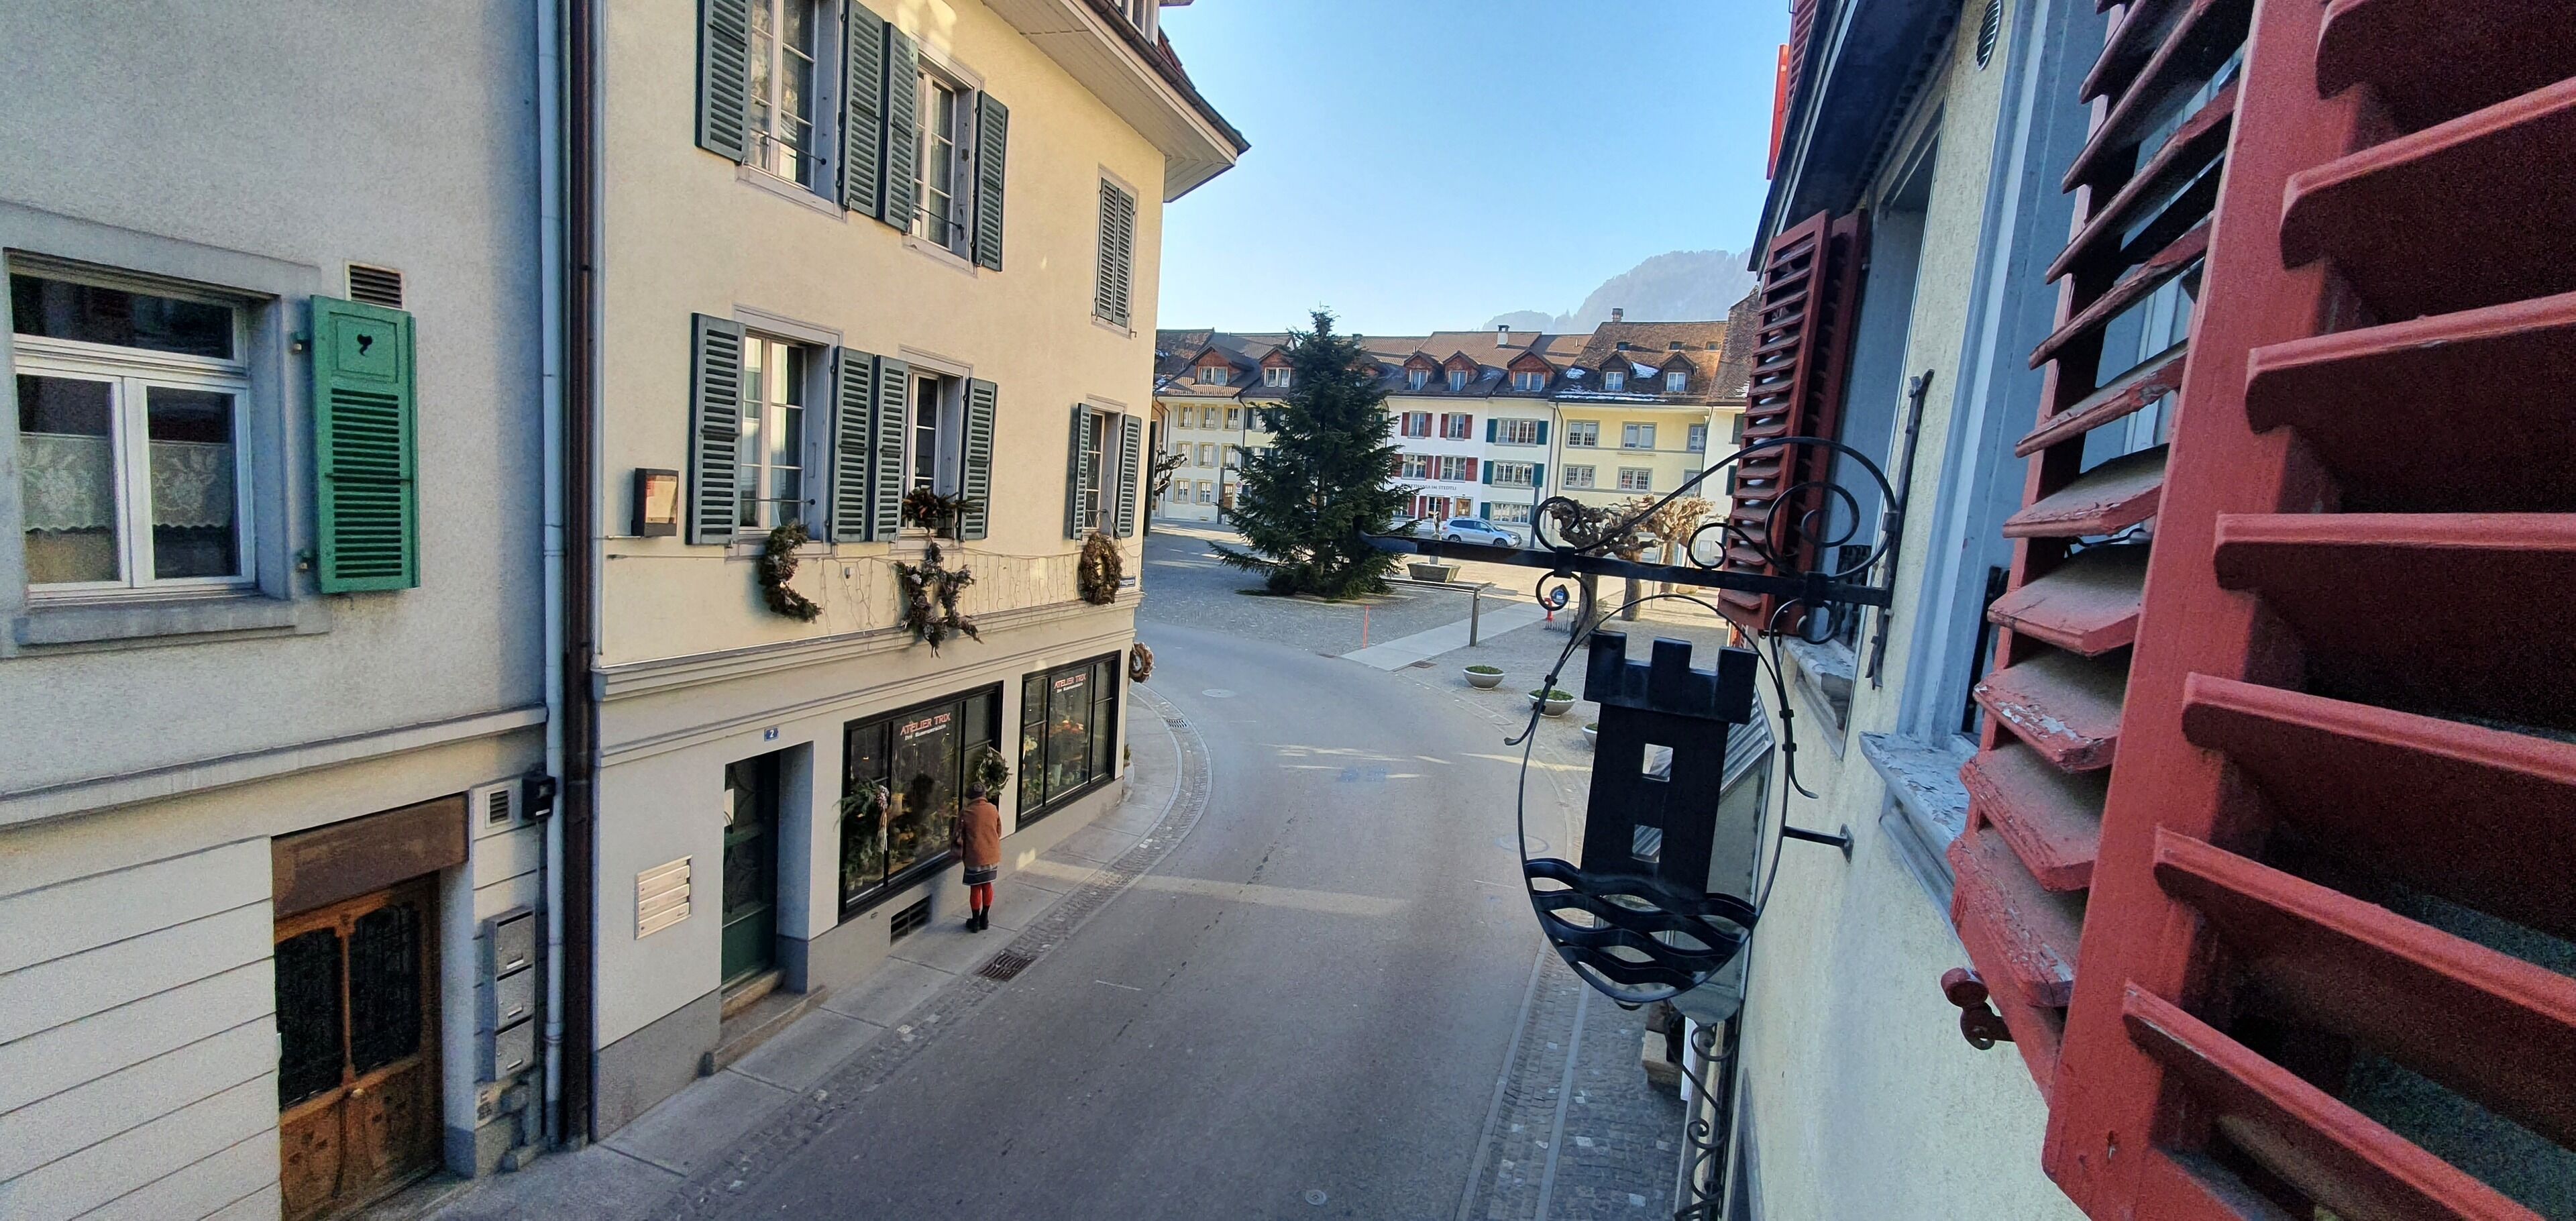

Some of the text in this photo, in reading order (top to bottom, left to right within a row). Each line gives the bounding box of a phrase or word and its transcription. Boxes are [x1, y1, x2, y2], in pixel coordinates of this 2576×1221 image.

[1054, 677, 1074, 689] ATELIER
[1075, 673, 1086, 683] TRIX
[900, 718, 932, 736] ATELIER
[934, 712, 951, 725] TRIX
[769, 729, 774, 738] 2
